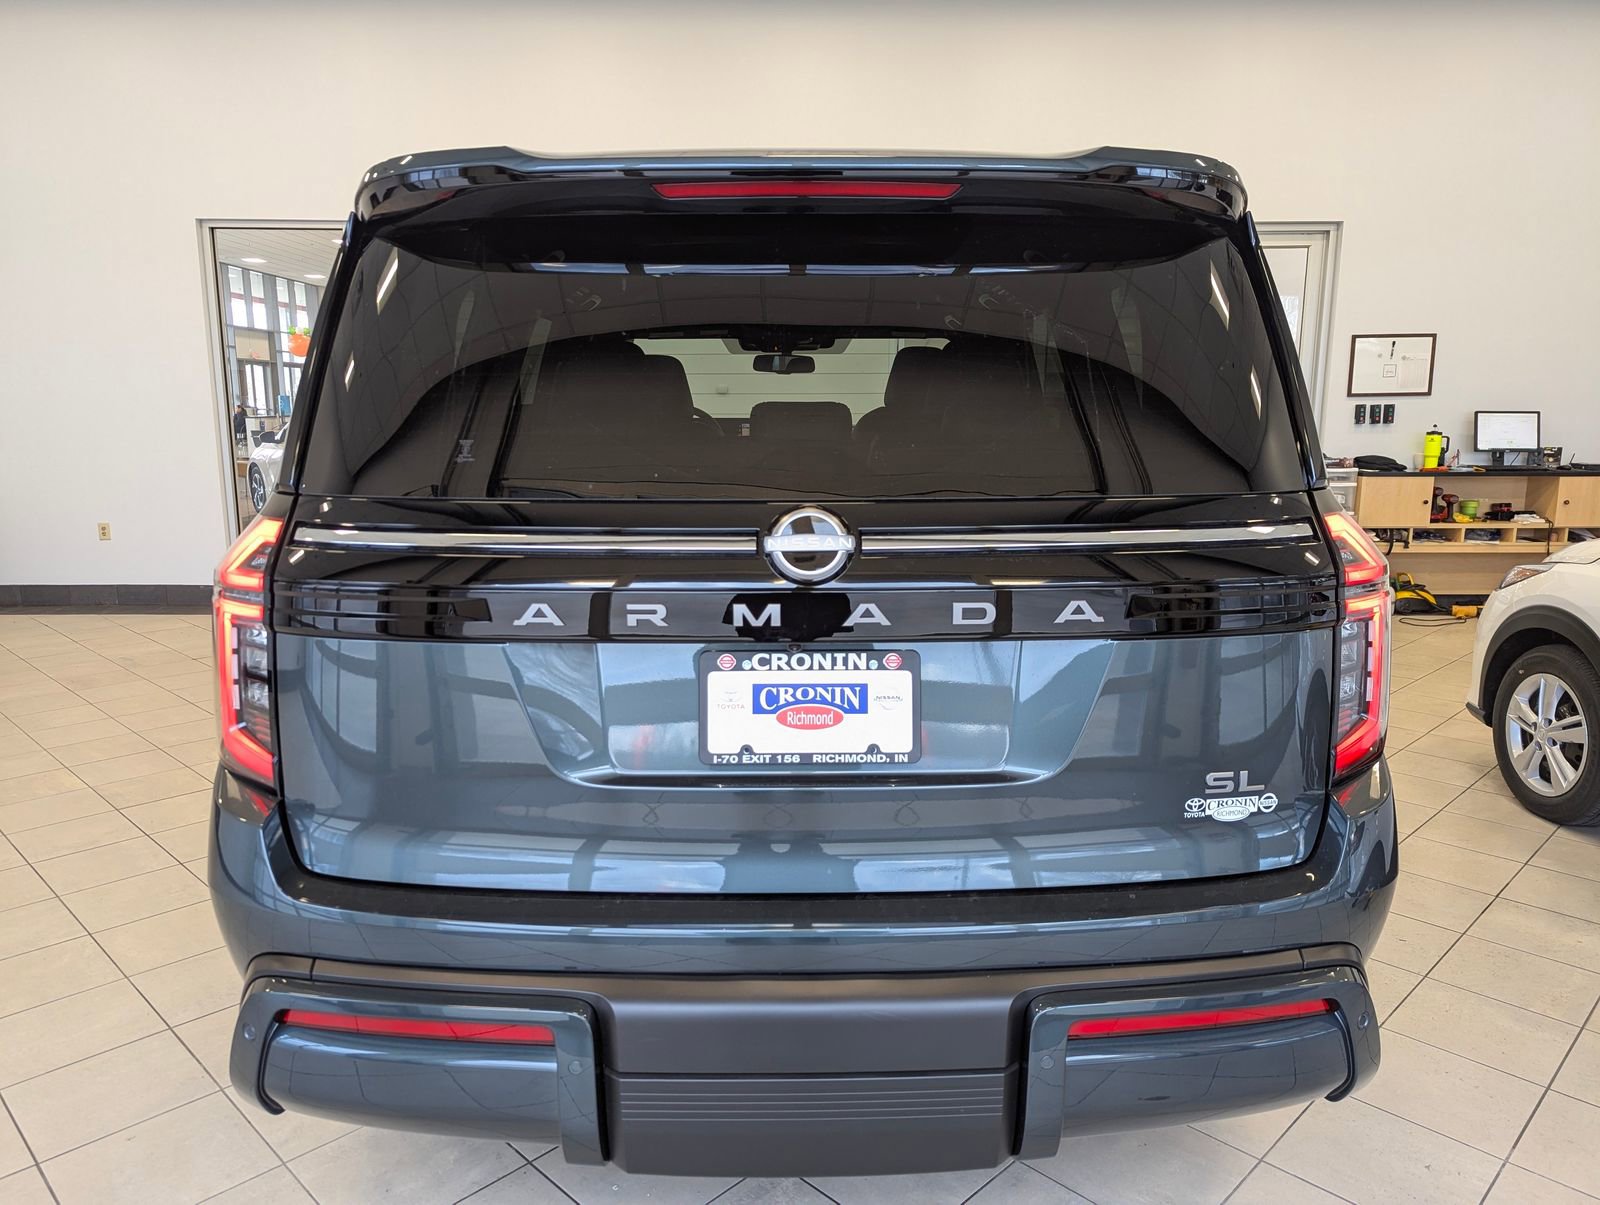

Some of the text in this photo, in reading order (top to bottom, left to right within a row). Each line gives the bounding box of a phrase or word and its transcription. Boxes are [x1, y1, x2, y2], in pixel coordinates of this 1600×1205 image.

[767, 537, 852, 549] NISSAN
[512, 600, 1105, 627] ARMADA
[751, 653, 868, 671] CRONIN
[759, 686, 861, 712] CRONIN
[787, 711, 834, 725] Richmond
[713, 753, 909, 763] I-70 EXIT 156 RICHMOND, IN
[1204, 770, 1265, 794] SL
[1207, 797, 1257, 811] CRONIN
